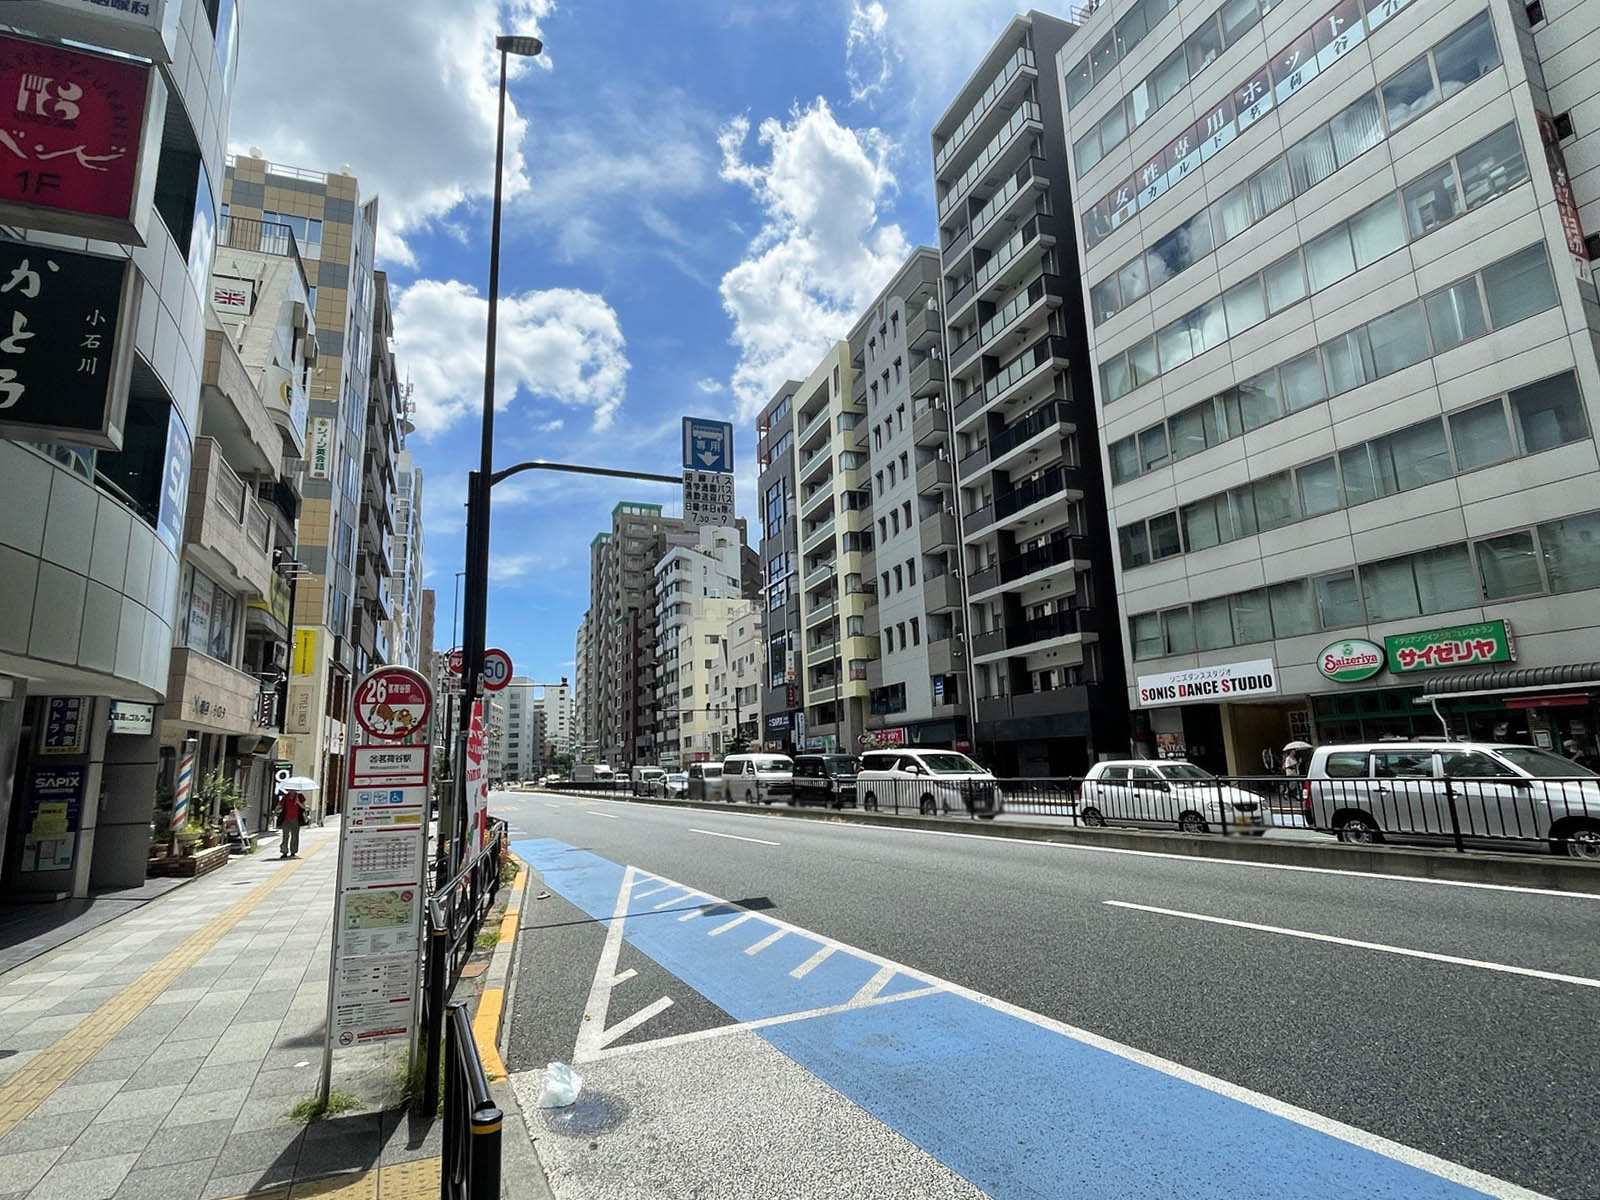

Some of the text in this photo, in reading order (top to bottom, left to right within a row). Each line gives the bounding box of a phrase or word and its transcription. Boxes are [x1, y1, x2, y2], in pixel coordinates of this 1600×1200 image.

[14, 170, 62, 195] 1F
[77, 308, 106, 376] 小石川
[1324, 653, 1379, 674] Saizeriya
[1398, 639, 1496, 668] サイゼリヤ
[483, 659, 506, 680] 50
[366, 678, 387, 704] 26
[1141, 673, 1273, 702] SONIS DANCE STUDIO
[35, 776, 81, 788] SAPIX
